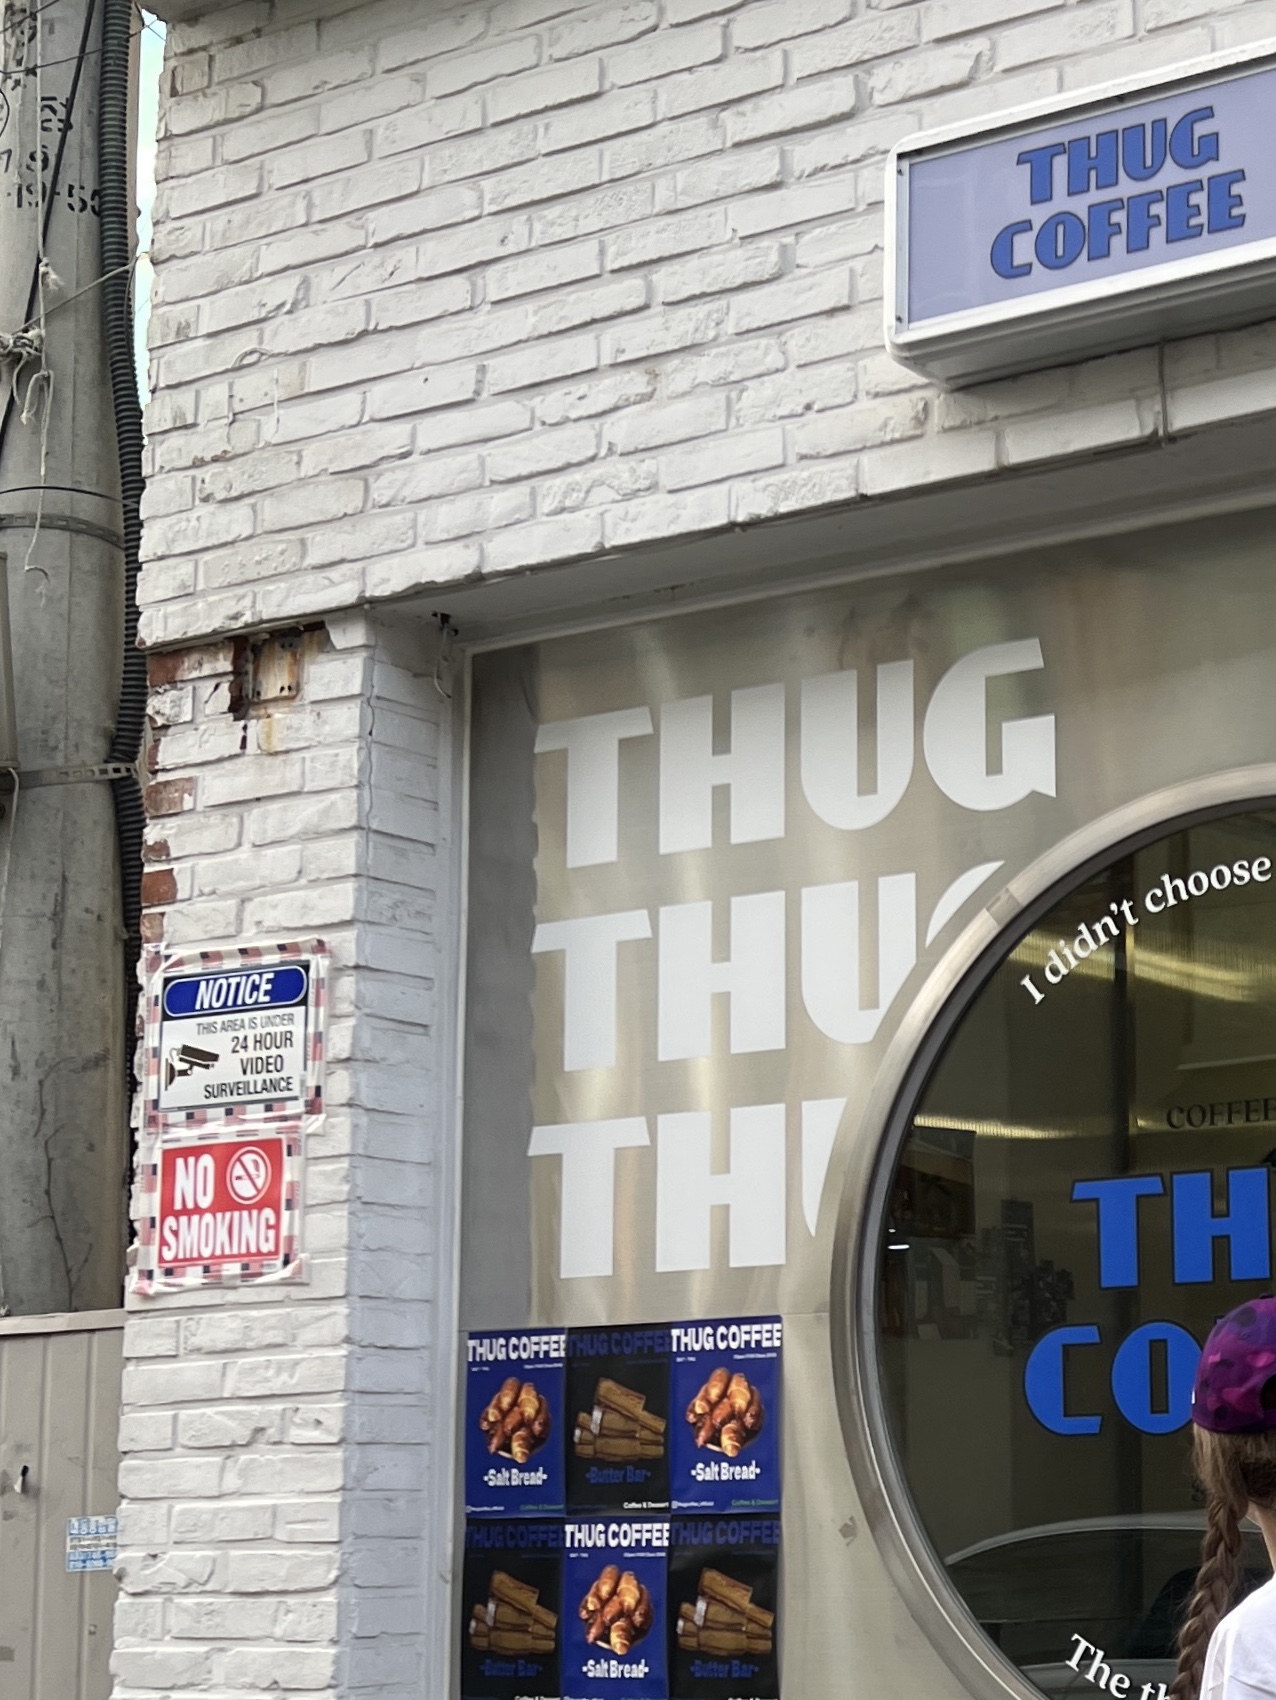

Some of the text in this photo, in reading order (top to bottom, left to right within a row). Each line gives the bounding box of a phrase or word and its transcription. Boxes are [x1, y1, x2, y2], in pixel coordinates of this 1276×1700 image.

[1016, 106, 1220, 206] THUG
[990, 169, 1247, 280] COFFEE
[533, 637, 1058, 869] THUG
[1020, 974, 1046, 1005] I
[1043, 898, 1140, 985] didn't
[1144, 855, 1272, 914] choose
[531, 860, 1005, 1072] THU
[195, 972, 275, 1010] NOTICE
[197, 1012, 295, 1035] THIS AREA IS UNDER
[231, 1030, 294, 1054] 24 HOUR
[204, 1076, 294, 1100] SURVEILLANCE
[240, 1054, 284, 1076] VIDEO
[173, 1153, 216, 1211] NO
[161, 1207, 276, 1262] SMOKING
[467, 1334, 566, 1362] THUG COFFEE
[671, 1323, 782, 1353] THUG COFFEE
[565, 1522, 670, 1548] THUG COFFEE
[1065, 1632, 1131, 1699] The
